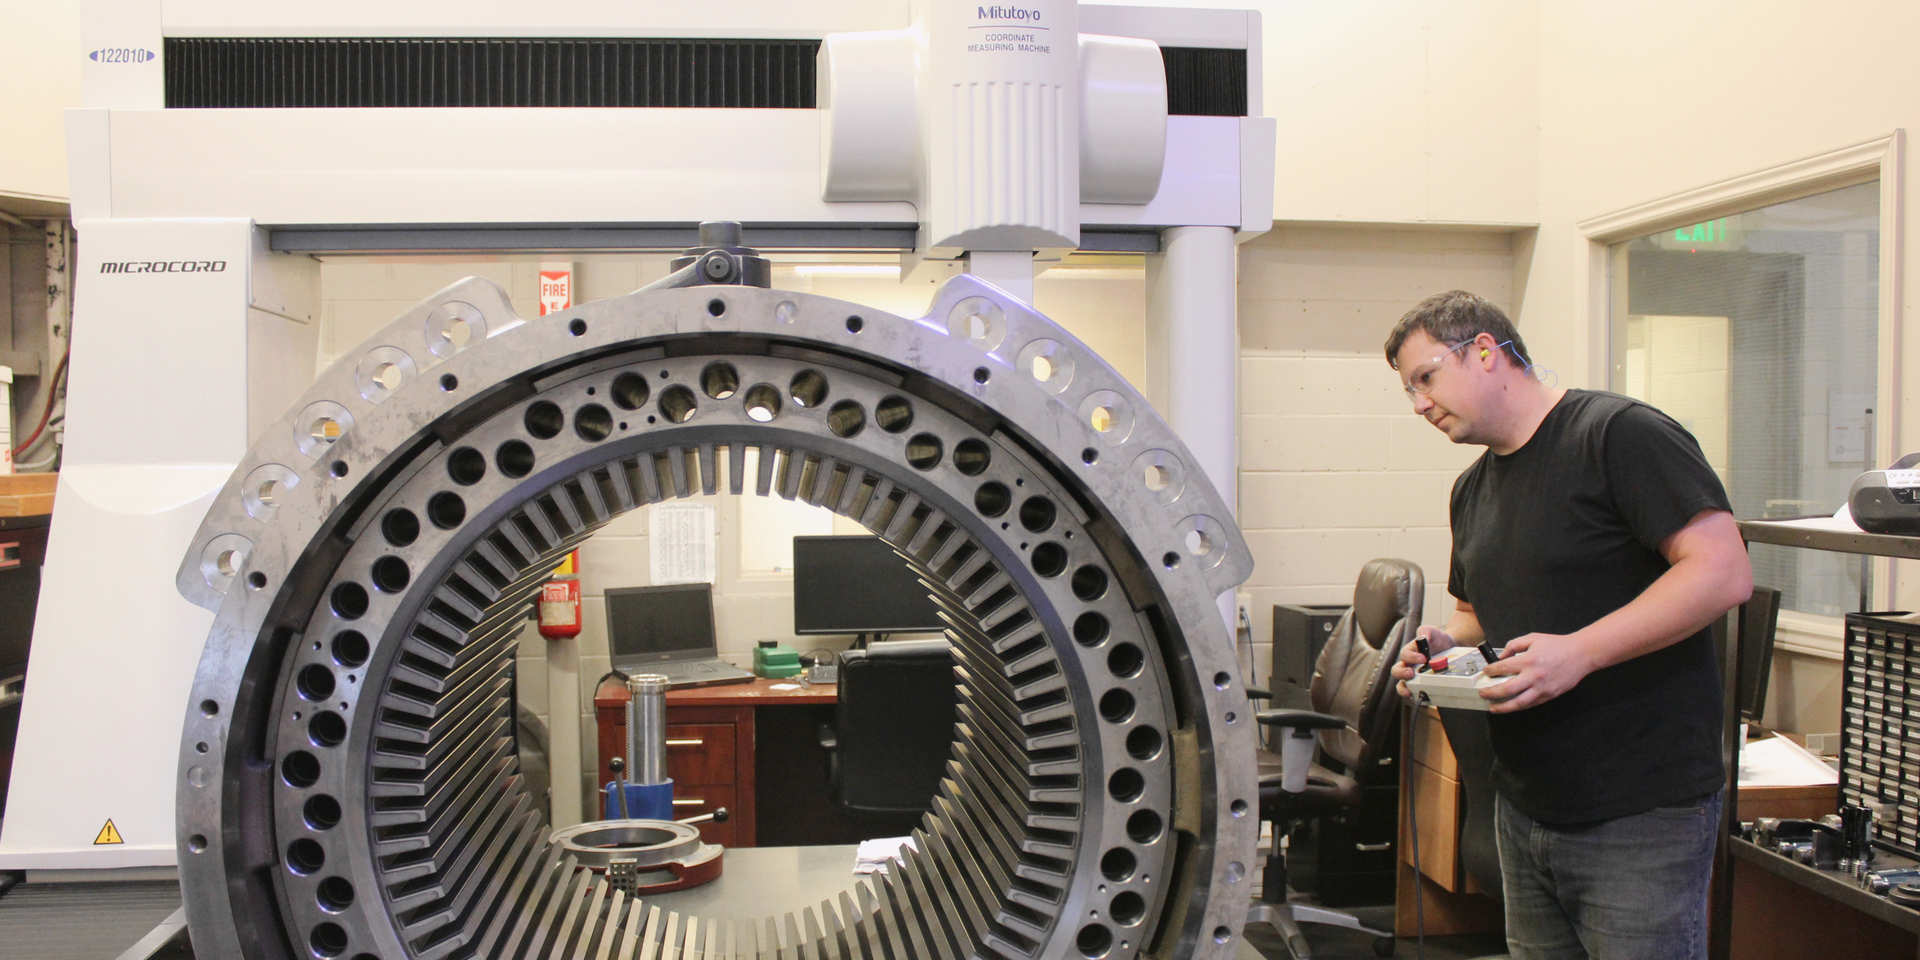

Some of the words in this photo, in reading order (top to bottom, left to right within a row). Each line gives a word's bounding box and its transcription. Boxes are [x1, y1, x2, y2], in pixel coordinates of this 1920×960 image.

[978, 6, 1040, 22] Mitutoyo
[985, 33, 1035, 42] COORDINATE
[968, 43, 1014, 52] MEASURING
[1018, 44, 1050, 53] MACHINE
[100, 48, 145, 63] 122010
[100, 261, 227, 273] MICROCORD
[543, 283, 566, 297] FIRE
